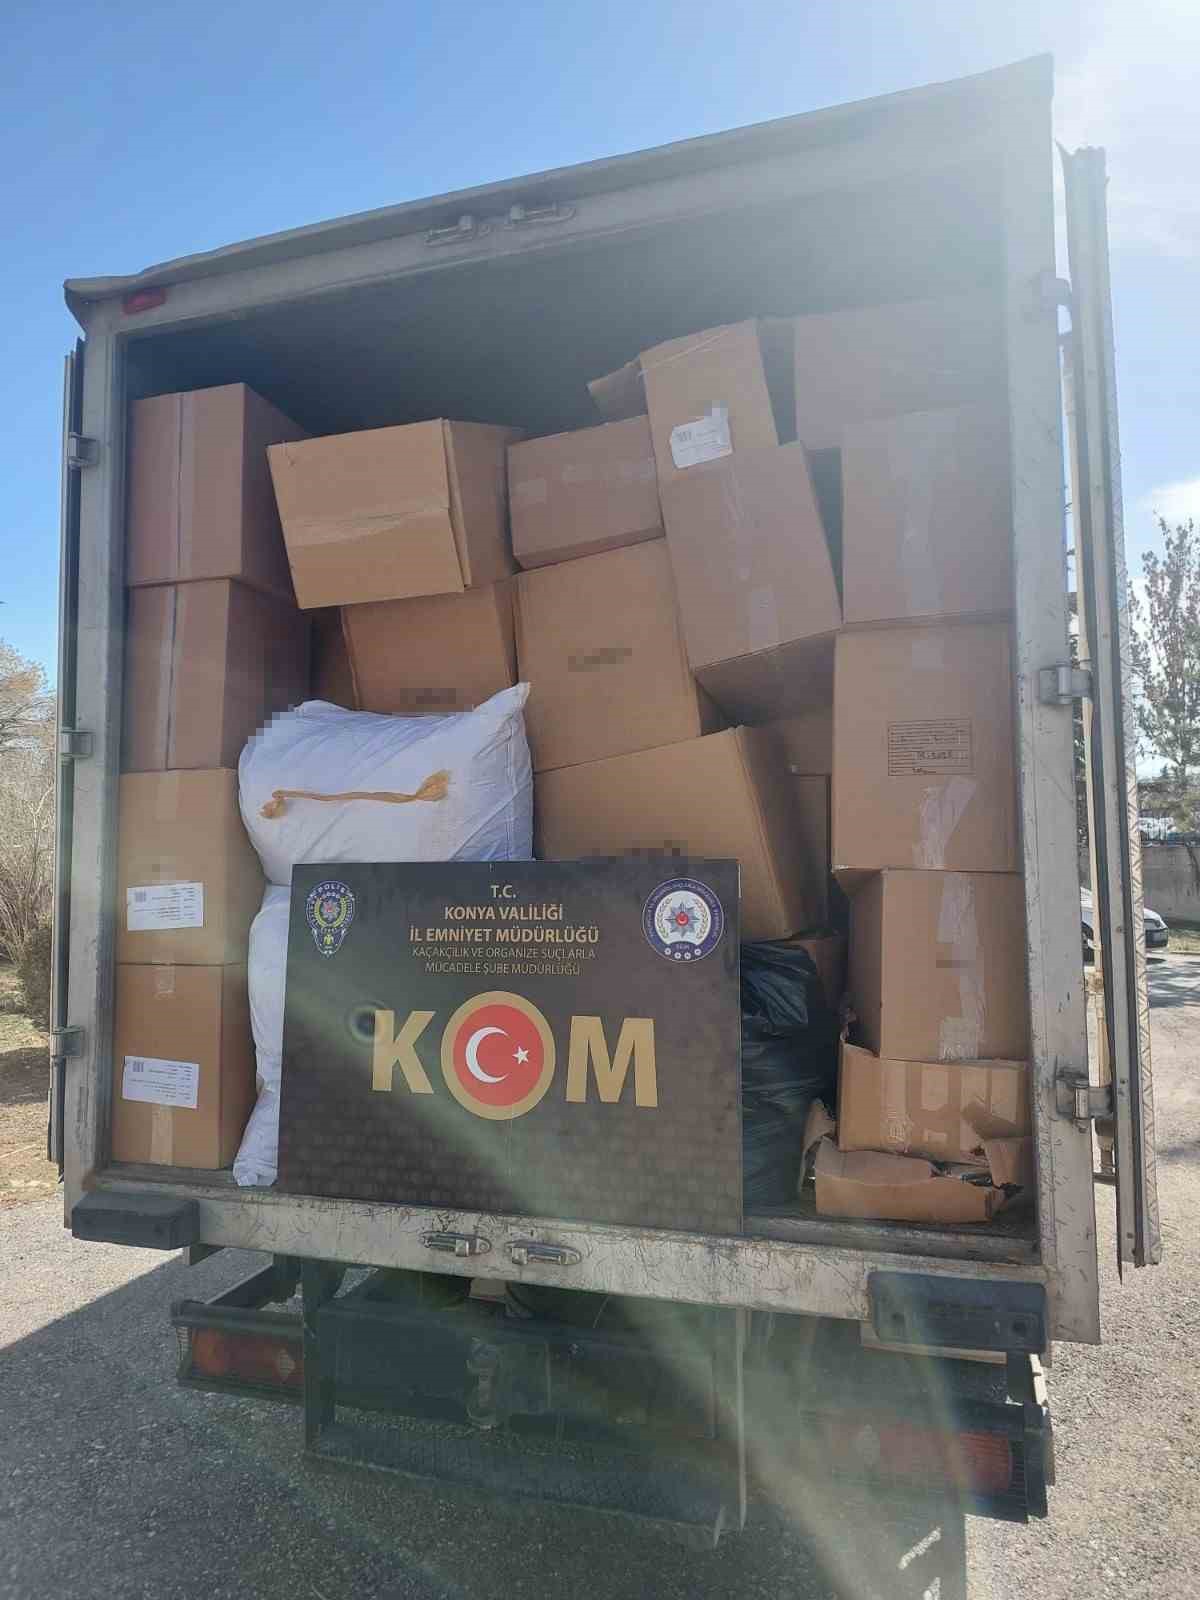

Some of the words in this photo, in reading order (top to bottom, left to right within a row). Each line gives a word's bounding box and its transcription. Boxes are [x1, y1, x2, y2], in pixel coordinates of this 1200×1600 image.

[490, 885, 516, 898] T.C.
[444, 906, 496, 920] KONYA
[499, 903, 563, 920] VALİLİĞİ
[409, 925, 423, 942] İL
[426, 925, 492, 942] EMNİYET
[496, 925, 599, 943] MÜDÜRLÜĞÜ
[471, 947, 484, 958] VE
[541, 947, 596, 961] SUÇLARLA
